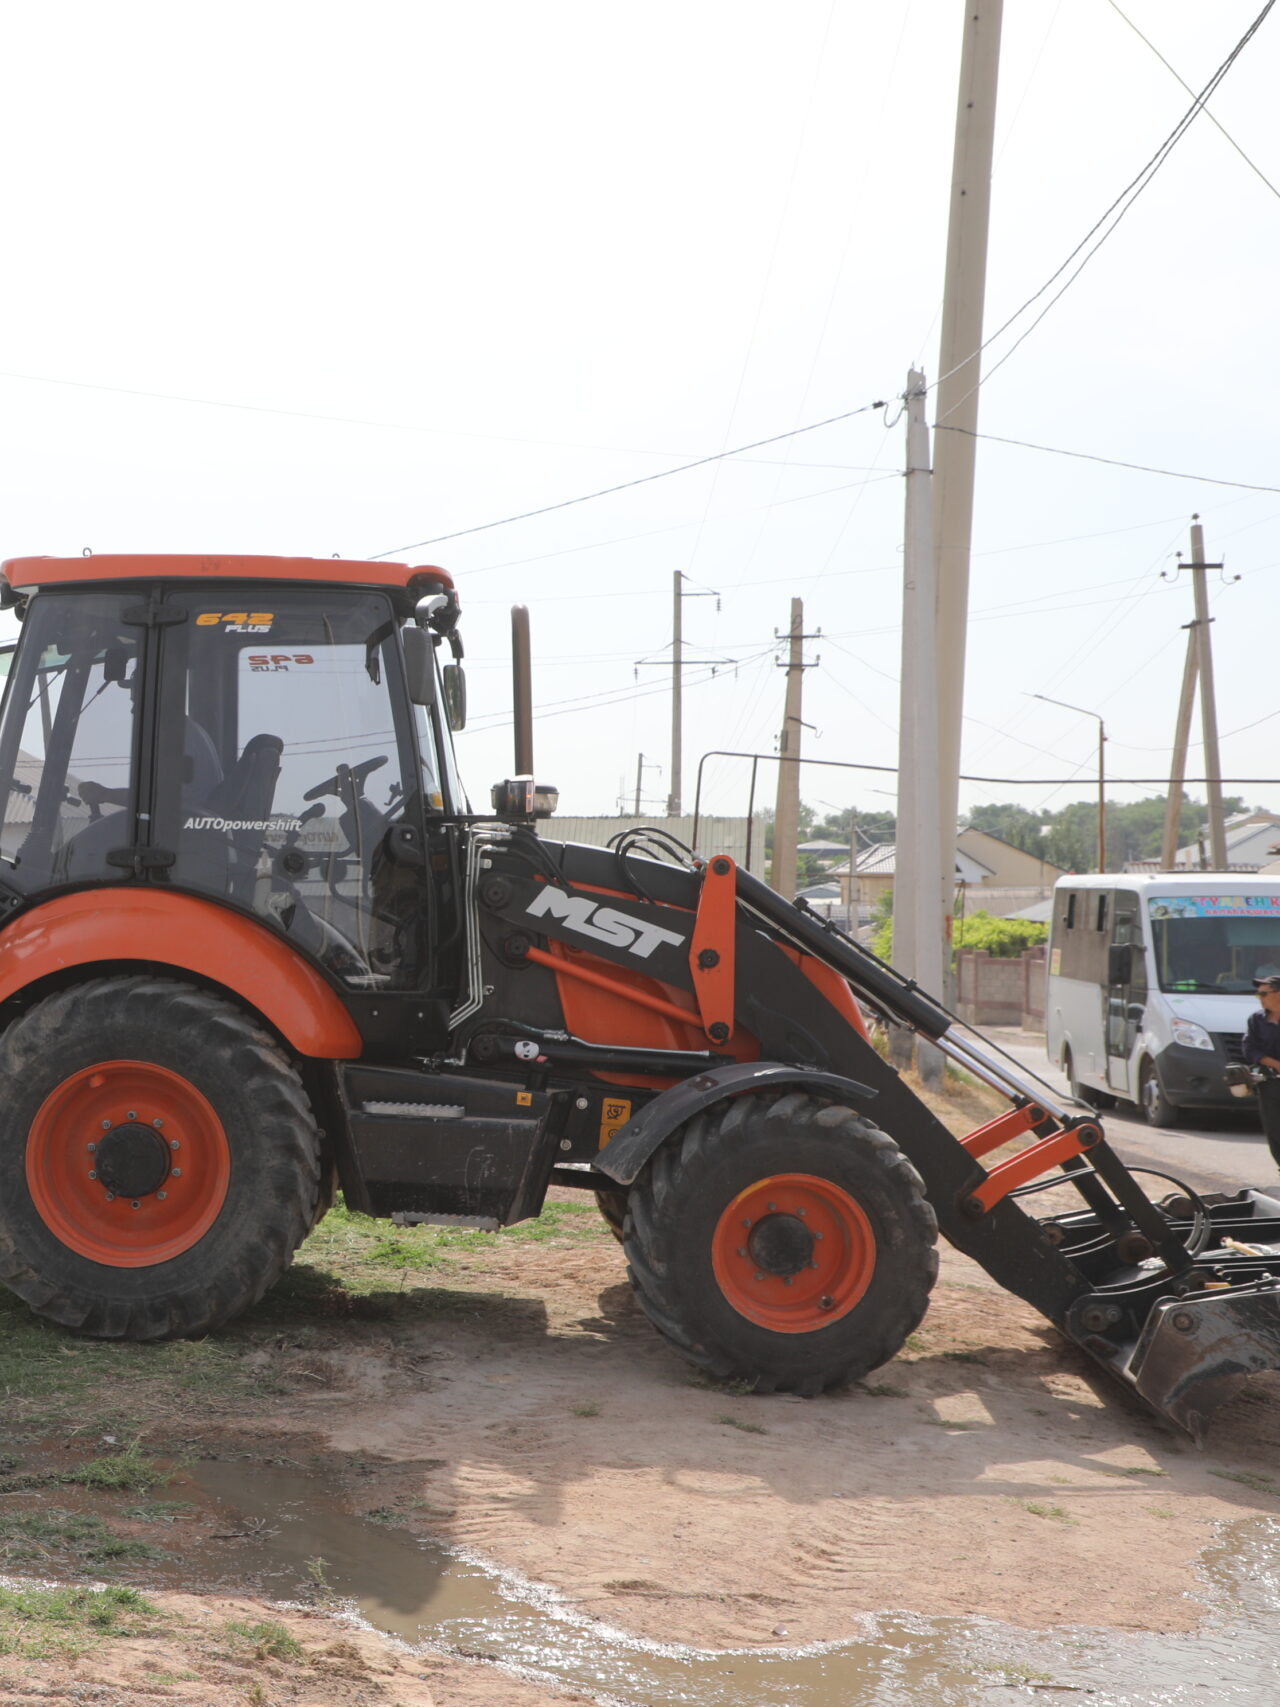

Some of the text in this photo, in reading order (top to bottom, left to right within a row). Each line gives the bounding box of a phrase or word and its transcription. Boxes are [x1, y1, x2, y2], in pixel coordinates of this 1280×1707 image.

[196, 612, 274, 626] 642
[224, 624, 271, 633] PLUS
[183, 817, 302, 832] AUTOpowershift
[525, 884, 686, 959] MST
